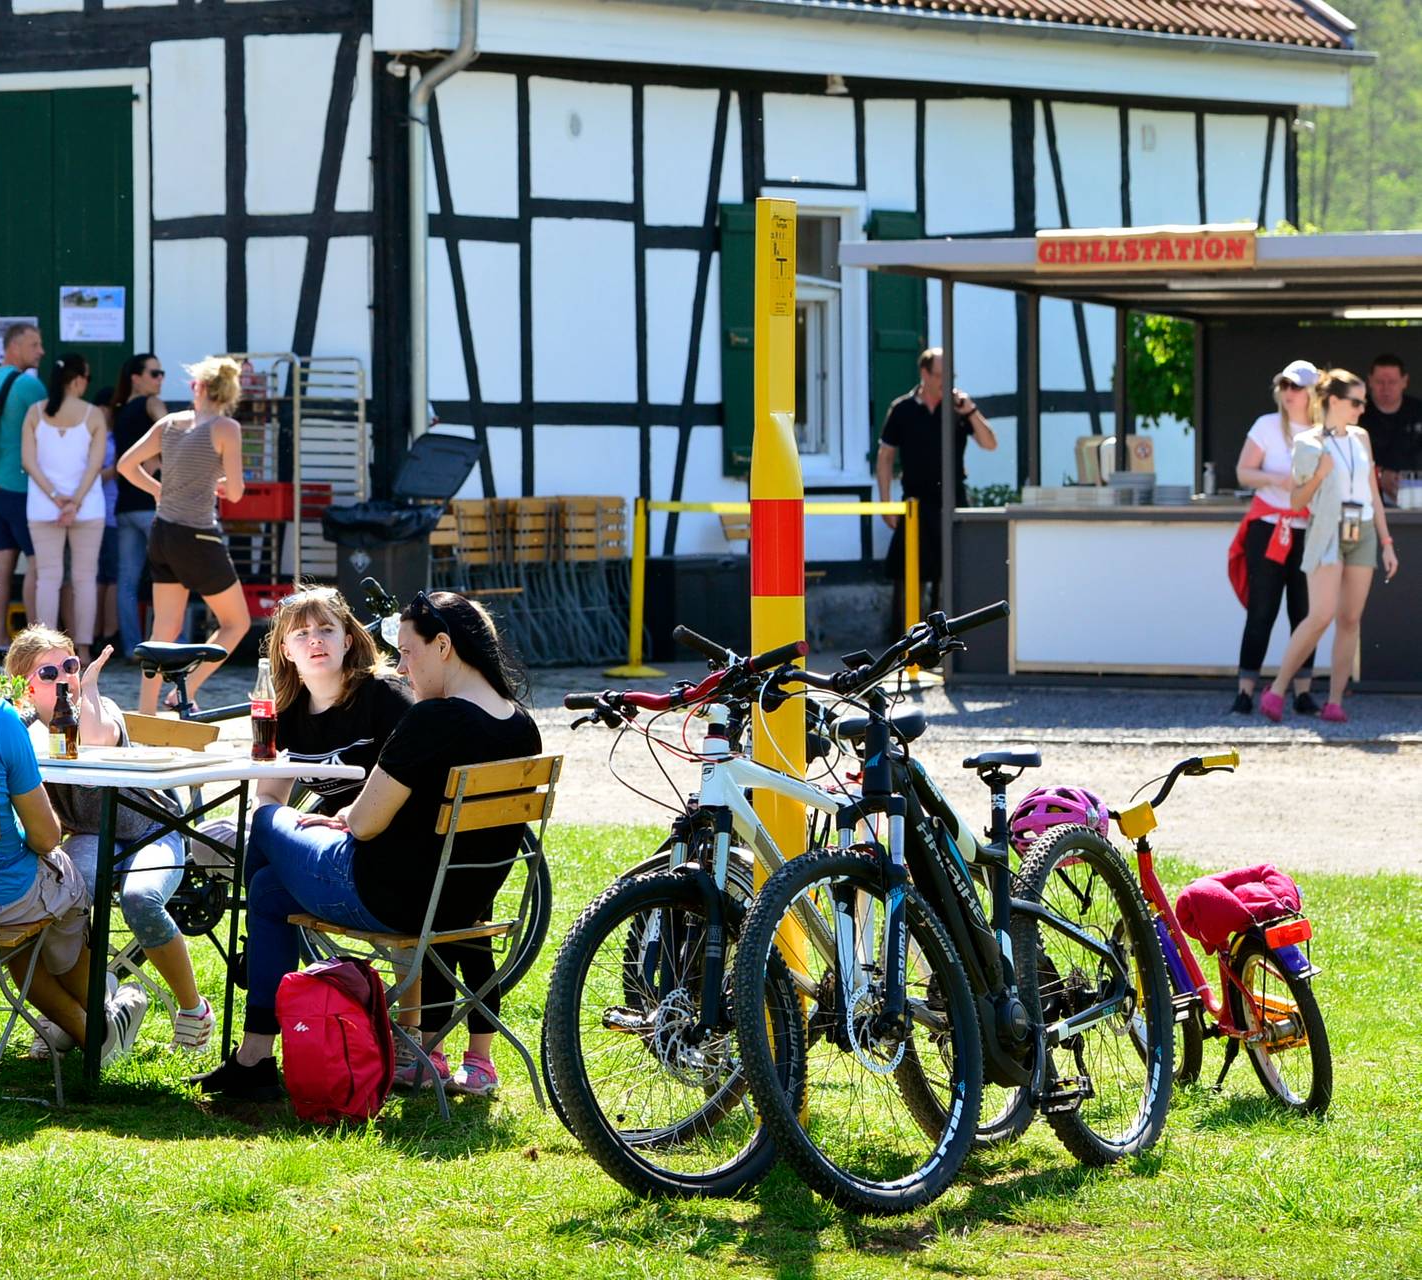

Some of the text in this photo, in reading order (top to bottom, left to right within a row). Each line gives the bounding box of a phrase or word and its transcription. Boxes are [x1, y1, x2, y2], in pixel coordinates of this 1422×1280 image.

[1038, 238, 1247, 264] GRILLSTATION
[1104, 851, 1148, 921] SCHWALBE
[918, 909, 955, 964] SMART
[777, 978, 800, 1108] SCHWALBE
